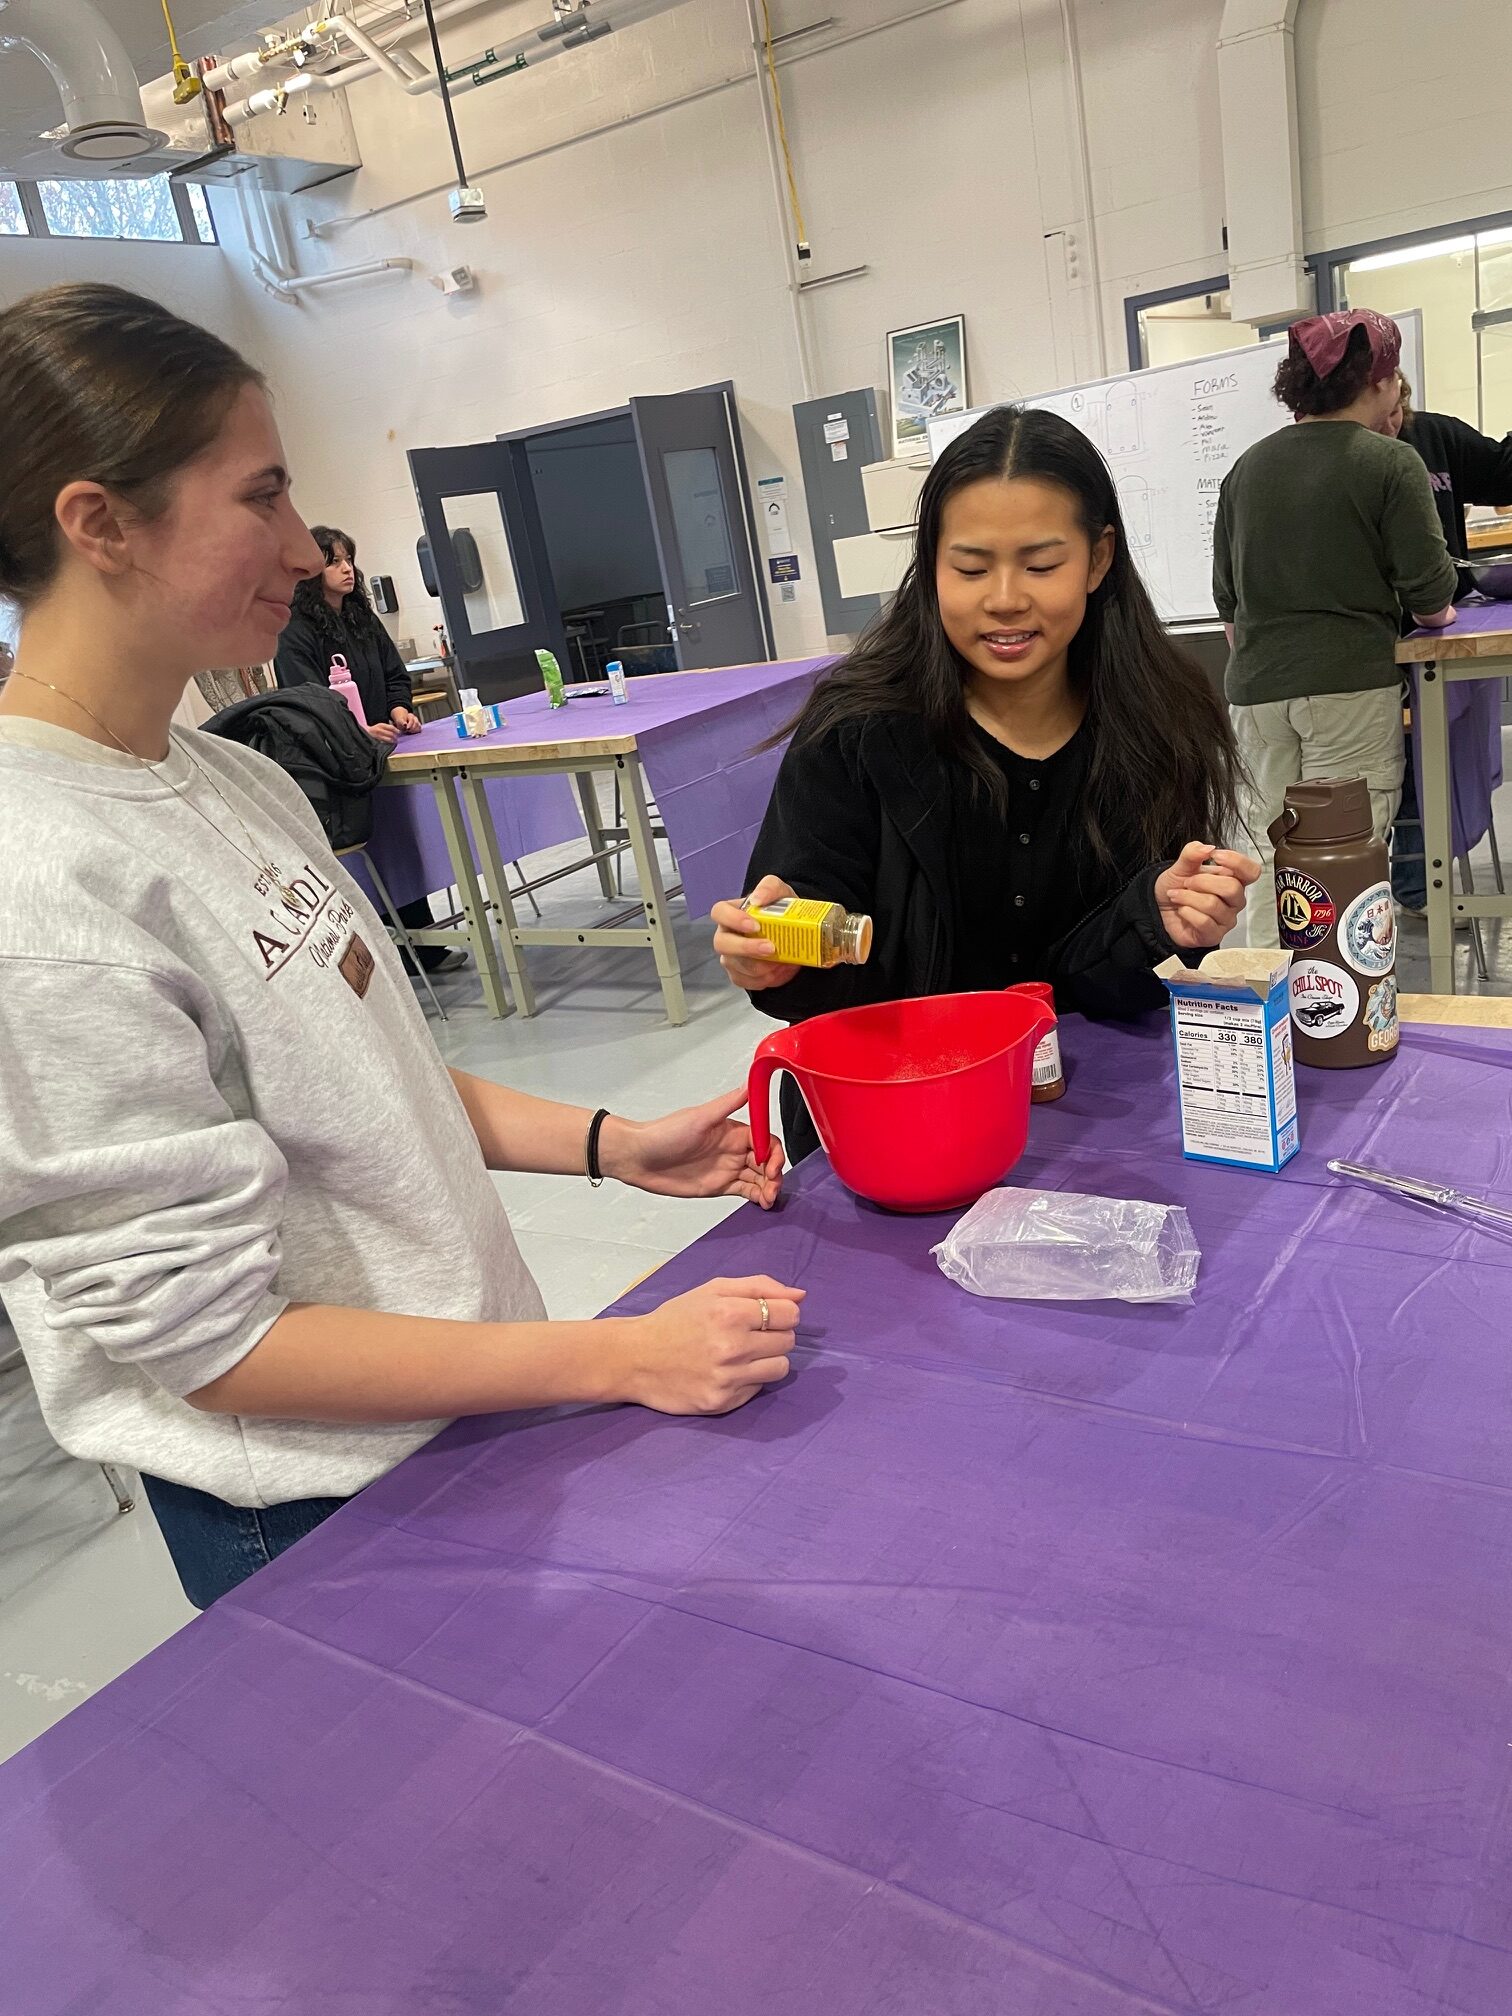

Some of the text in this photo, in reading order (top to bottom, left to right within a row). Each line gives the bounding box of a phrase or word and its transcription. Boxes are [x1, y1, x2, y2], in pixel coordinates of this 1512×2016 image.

[1194, 373, 1238, 396] FORMS
[1285, 873, 1323, 903] HARBOR
[1313, 909, 1333, 919] 1796
[1307, 965, 1318, 974] the
[1292, 975, 1343, 998] CHILL SPOT
[1177, 999, 1213, 1009] Nutrition
[1215, 1002, 1239, 1012] Facts
[1178, 1030, 1209, 1039] Calories
[1217, 1033, 1237, 1042] 330
[1243, 1036, 1263, 1045] 380
